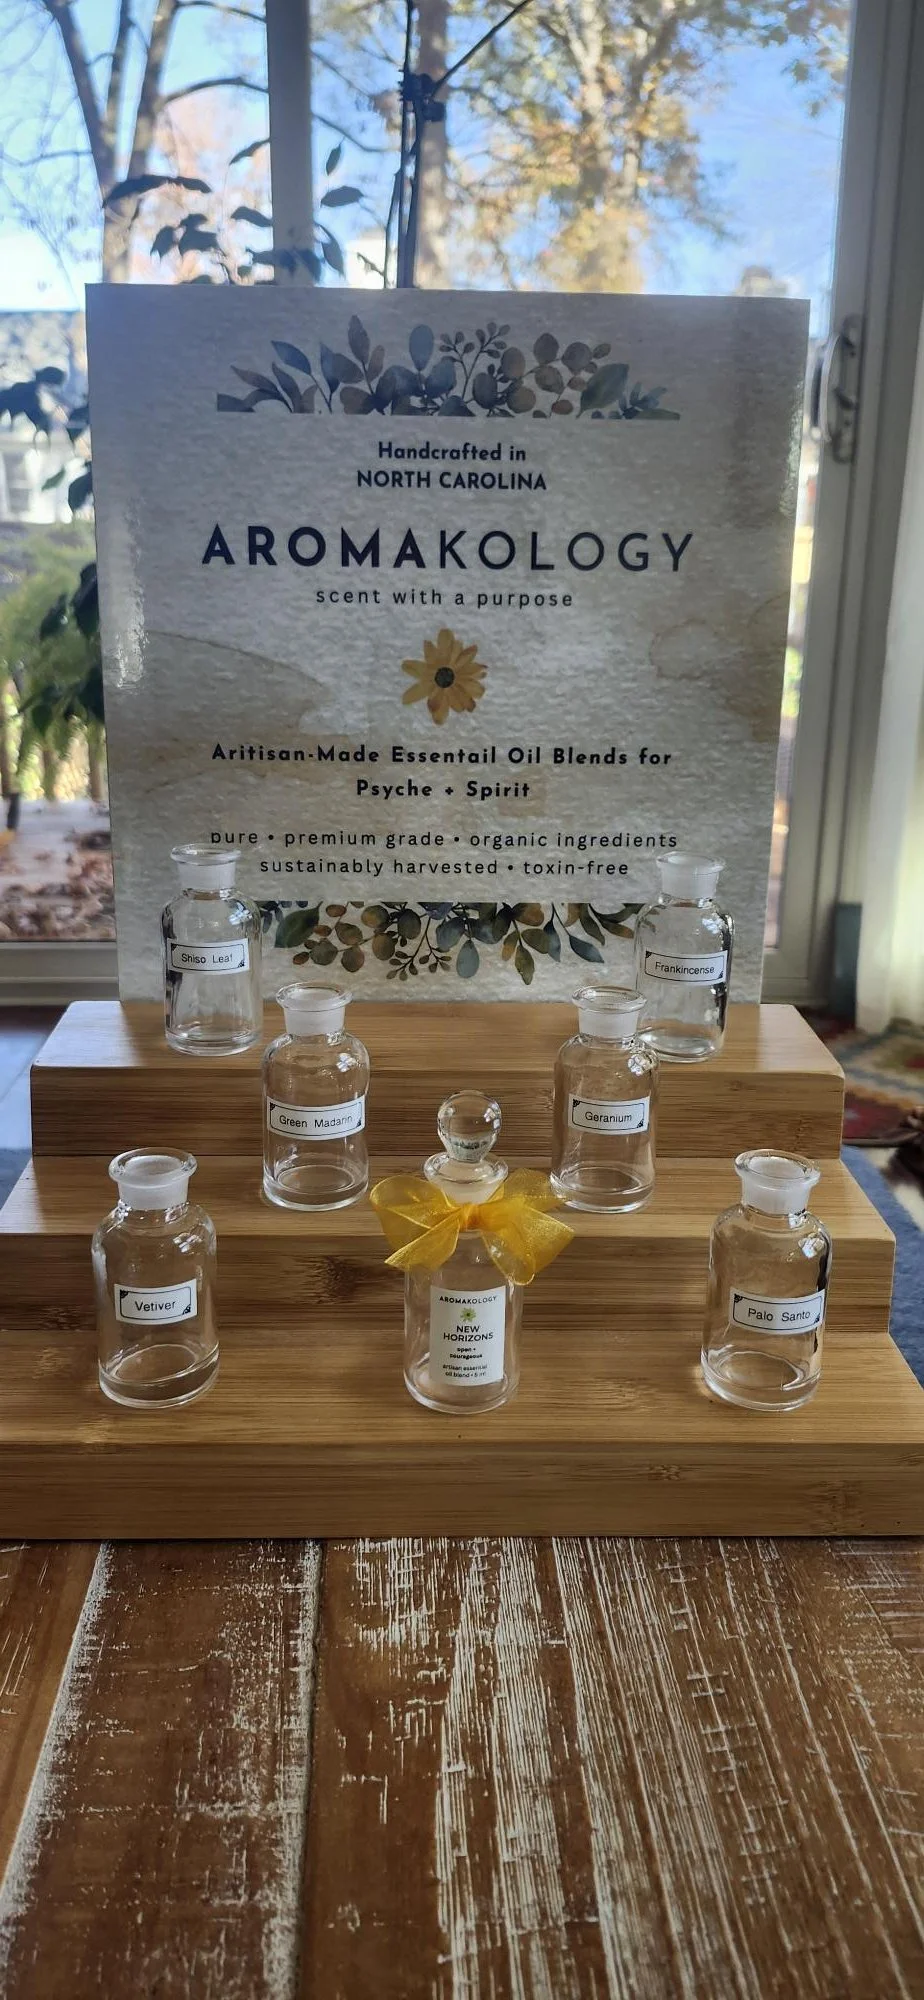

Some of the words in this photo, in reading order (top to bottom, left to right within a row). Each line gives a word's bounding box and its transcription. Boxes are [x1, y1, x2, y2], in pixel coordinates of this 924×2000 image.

[378, 441, 502, 461] Handcrafted
[509, 446, 526, 461] in
[357, 470, 431, 488] NORTH
[439, 472, 547, 490] CAROLINA
[202, 523, 693, 572] AROMAKOLOGY
[316, 589, 381, 604] scent
[393, 589, 442, 605] with
[455, 592, 464, 605] a
[477, 592, 573, 609] purpose
[212, 743, 379, 762] Aritisan-Made
[392, 746, 496, 763] Essentail
[508, 746, 541, 764] Oil
[553, 747, 628, 765] Blends
[638, 747, 672, 765] for
[356, 779, 433, 800] Psyche
[445, 786, 454, 795] +
[466, 780, 530, 800] Spirit
[211, 831, 258, 844] pure
[285, 831, 376, 847] premium
[386, 832, 444, 849] grade
[470, 832, 548, 850] organic
[557, 832, 677, 850] ingredients
[260, 858, 383, 876] sustainably
[393, 859, 498, 874] harvested
[524, 860, 629, 875] toxin-free
[181, 953, 206, 963] Shiso
[212, 954, 233, 963] Leaf
[655, 961, 715, 975] Frankincense
[279, 1115, 307, 1127] Green
[585, 1111, 632, 1122] Geranium
[134, 1301, 176, 1312] Vetiver
[439, 1296, 497, 1304] AROMAKOLOGY
[748, 1307, 773, 1321] Palo
[781, 1310, 811, 1322] Santo
[456, 1325, 480, 1333] NEW
[443, 1332, 494, 1342] HORIZONS
